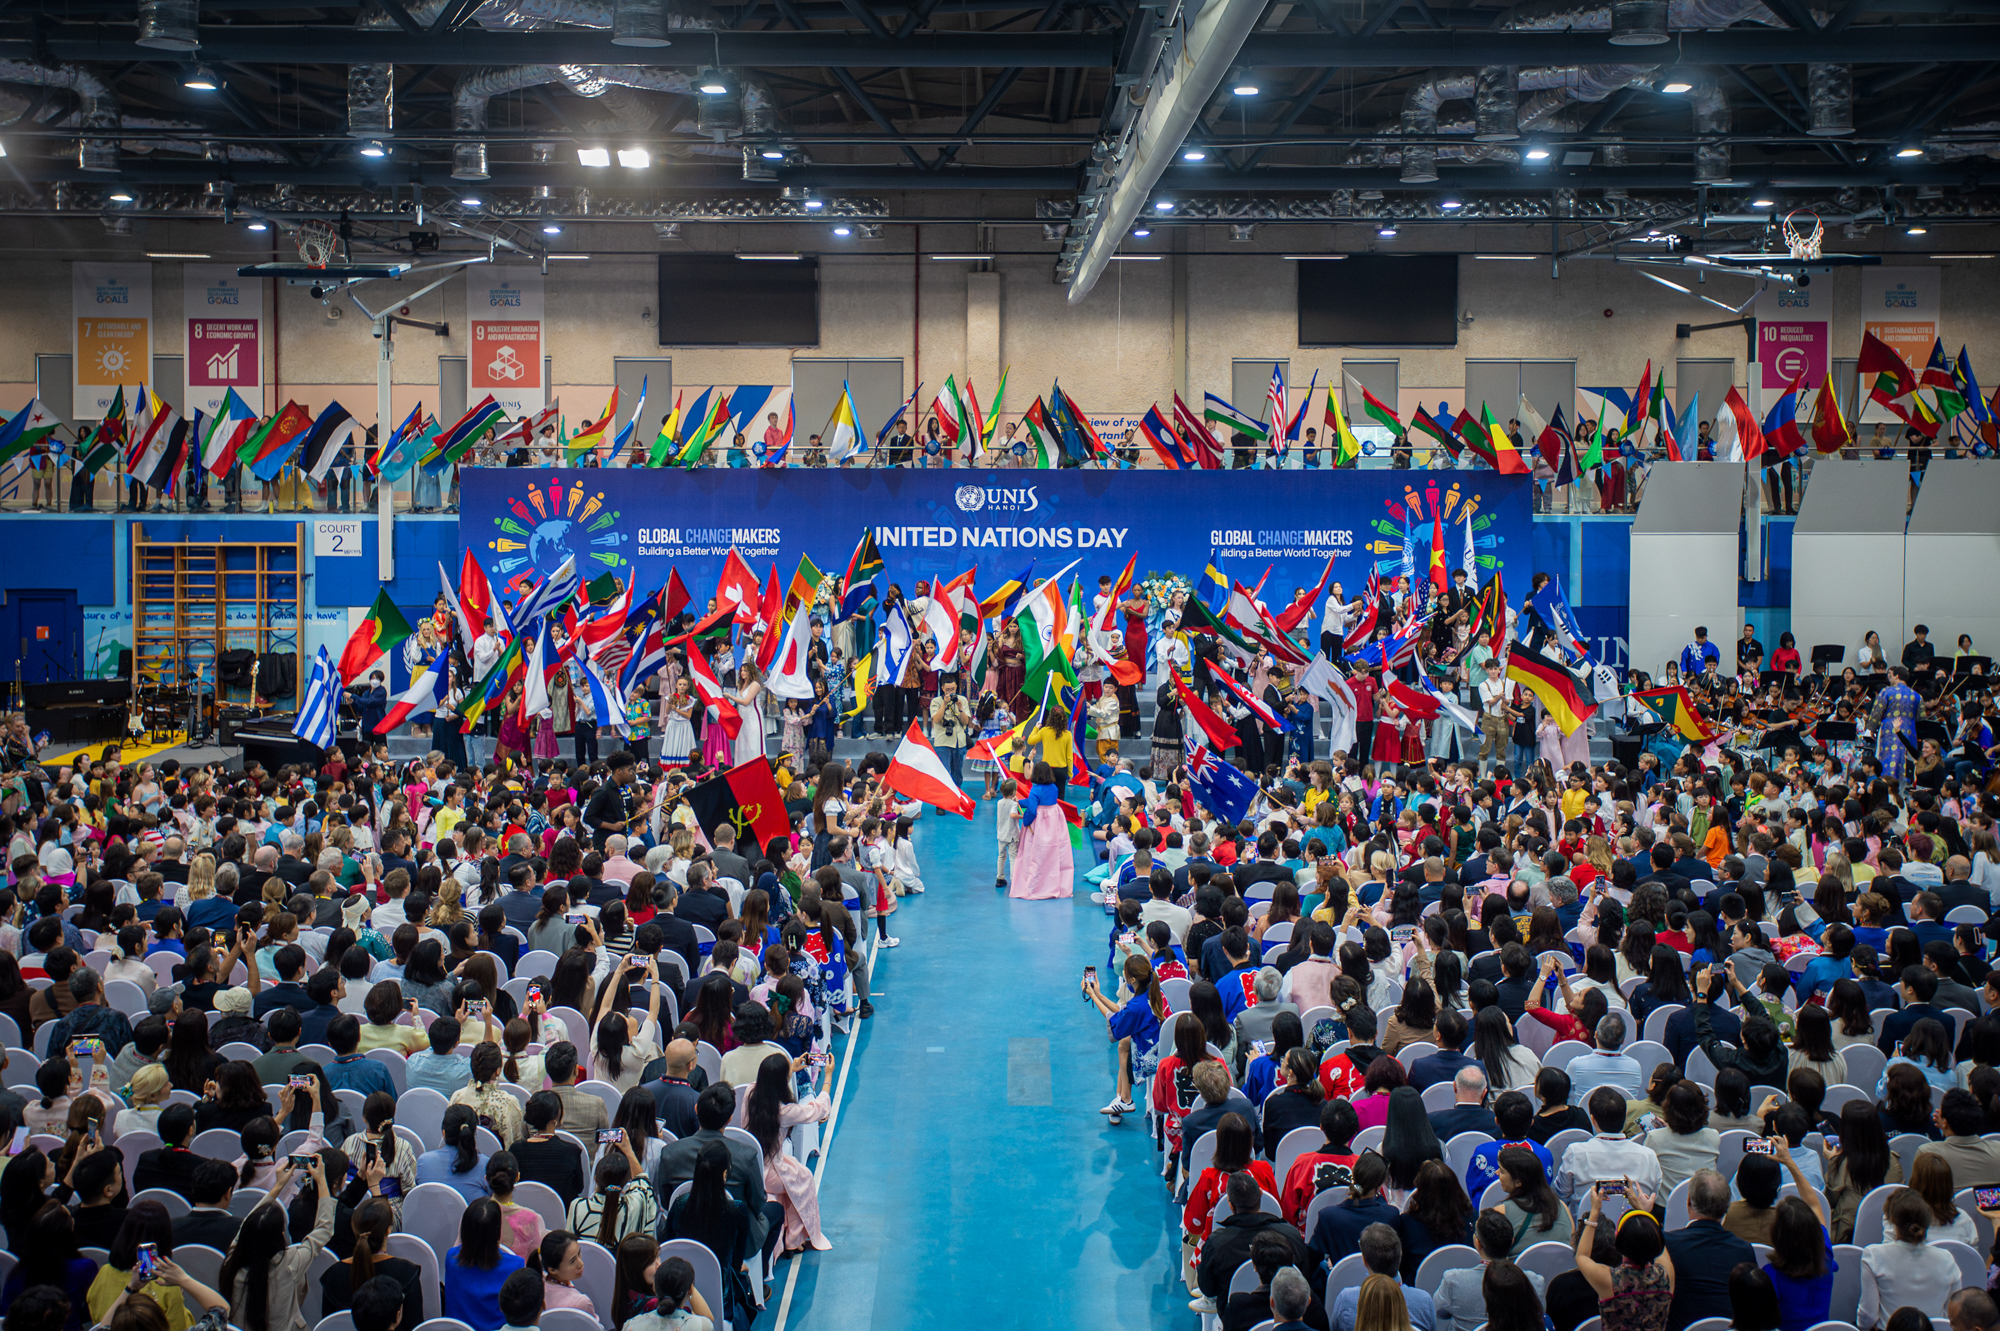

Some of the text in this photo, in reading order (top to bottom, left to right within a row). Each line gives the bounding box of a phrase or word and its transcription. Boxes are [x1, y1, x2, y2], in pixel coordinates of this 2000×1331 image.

[97, 296, 129, 304] GOALS
[207, 297, 239, 305] GOALS
[490, 298, 521, 307] GOALS
[84, 322, 92, 337] 7
[194, 323, 203, 339] 8
[476, 325, 485, 340] 9
[1763, 326, 1777, 341] 10
[502, 401, 522, 410] UNIS
[1112, 417, 1125, 427] of
[986, 486, 1039, 512] UNIS
[319, 524, 357, 533] COURT
[638, 528, 781, 544] GLOBAL CHANGEMAKERS
[962, 526, 1073, 548] NATIONS
[1077, 528, 1129, 548] DAY
[1211, 530, 1353, 546] GLOBAL CHANGEMAKERS
[332, 535, 343, 552] 2
[638, 546, 780, 558] Building a Better Wor Together
[1255, 548, 1282, 557] Better
[1283, 548, 1309, 557] World
[1311, 548, 1352, 560] Together
[110, 611, 121, 620] of
[236, 611, 248, 620] do
